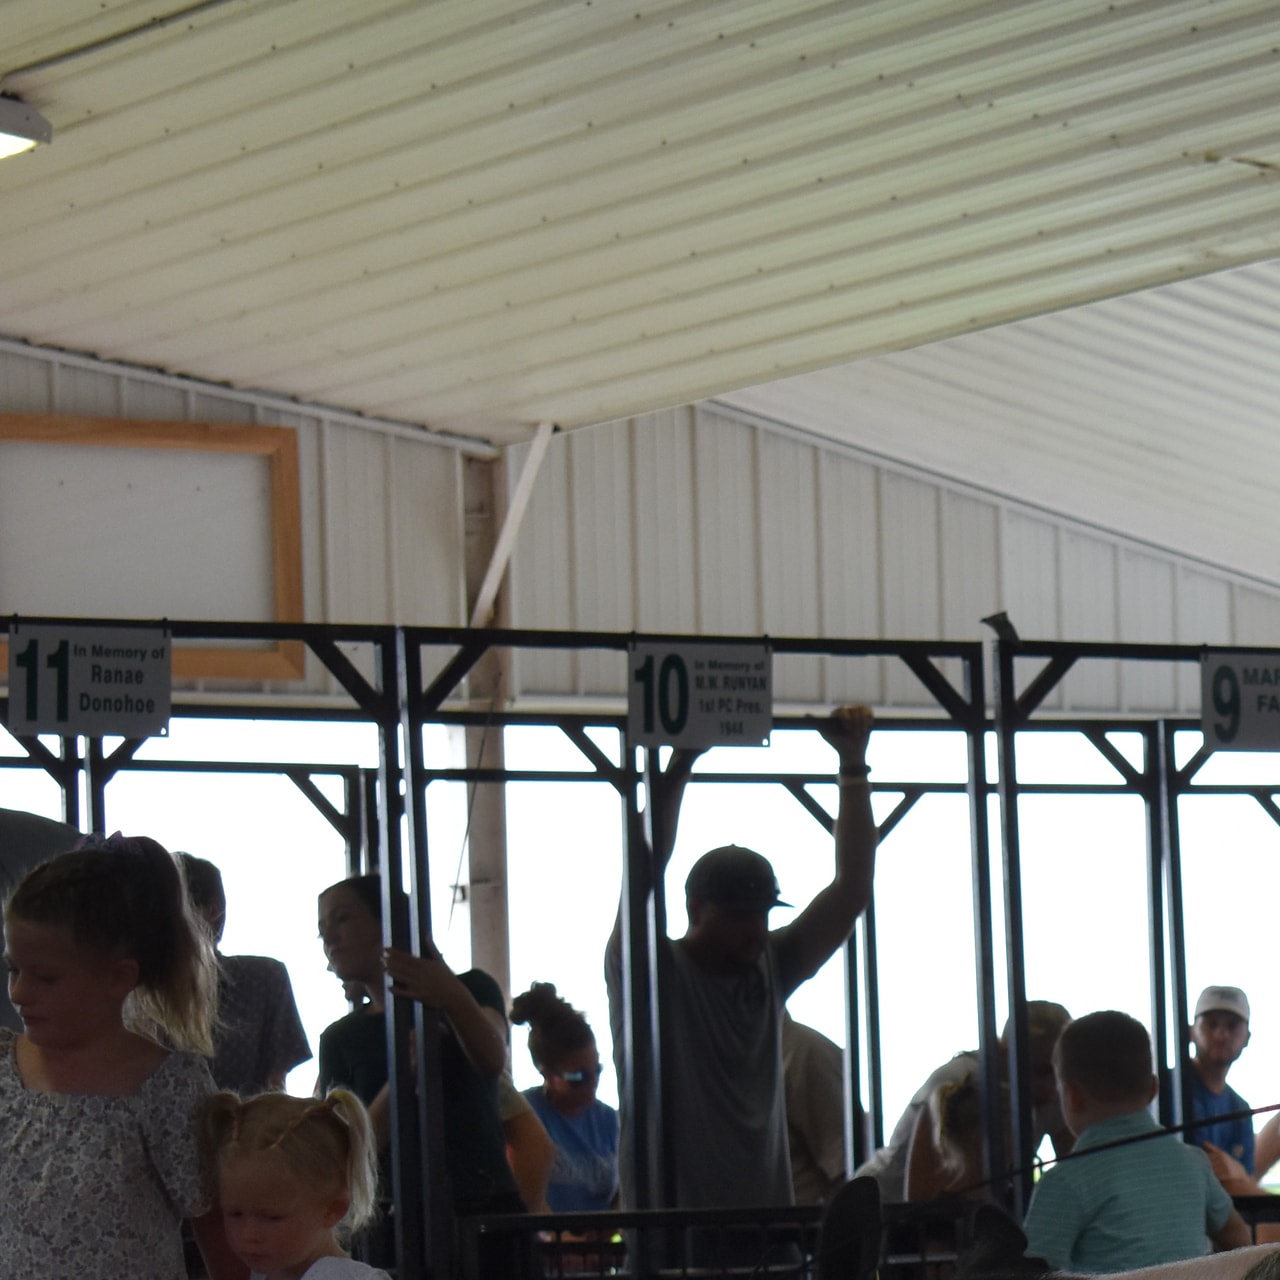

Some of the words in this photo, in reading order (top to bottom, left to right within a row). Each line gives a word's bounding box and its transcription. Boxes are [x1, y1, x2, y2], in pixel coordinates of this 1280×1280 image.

[74, 644, 87, 657] In
[91, 644, 149, 662] Memory
[152, 646, 166, 660] of
[91, 664, 145, 685] Ranae
[708, 659, 752, 673] Memory
[16, 638, 69, 723] 11
[79, 693, 156, 714] Donohoe
[634, 653, 690, 737] 10
[718, 697, 733, 713] PC
[1212, 664, 1241, 745] 9
